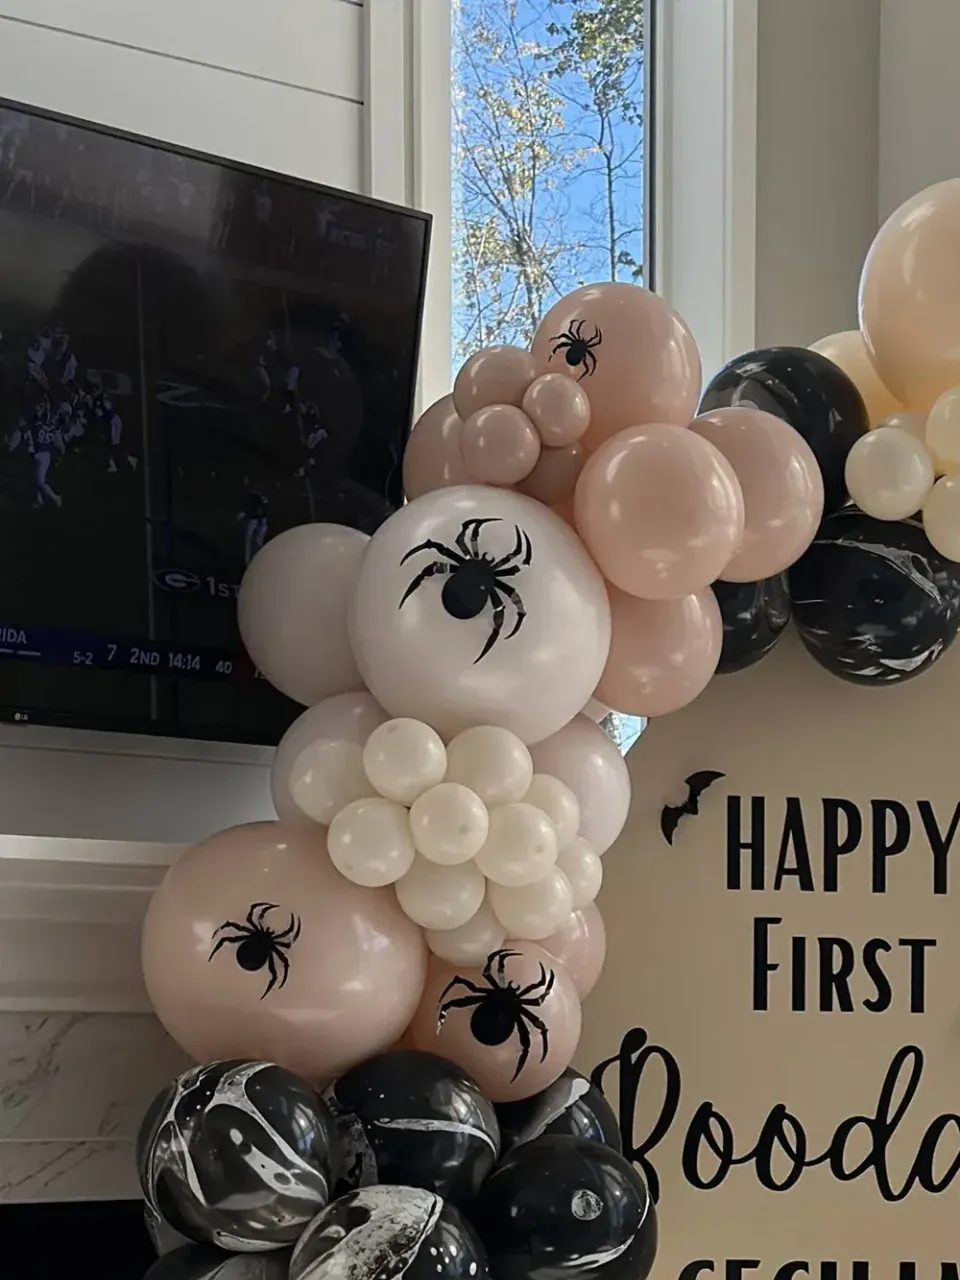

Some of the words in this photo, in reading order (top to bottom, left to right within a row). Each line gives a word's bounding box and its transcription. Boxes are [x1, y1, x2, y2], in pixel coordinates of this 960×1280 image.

[72, 651, 94, 665] 5-2
[107, 643, 118, 661] 7
[129, 647, 160, 666] 2ND
[168, 652, 201, 671] 14:14
[215, 660, 232, 674] 40
